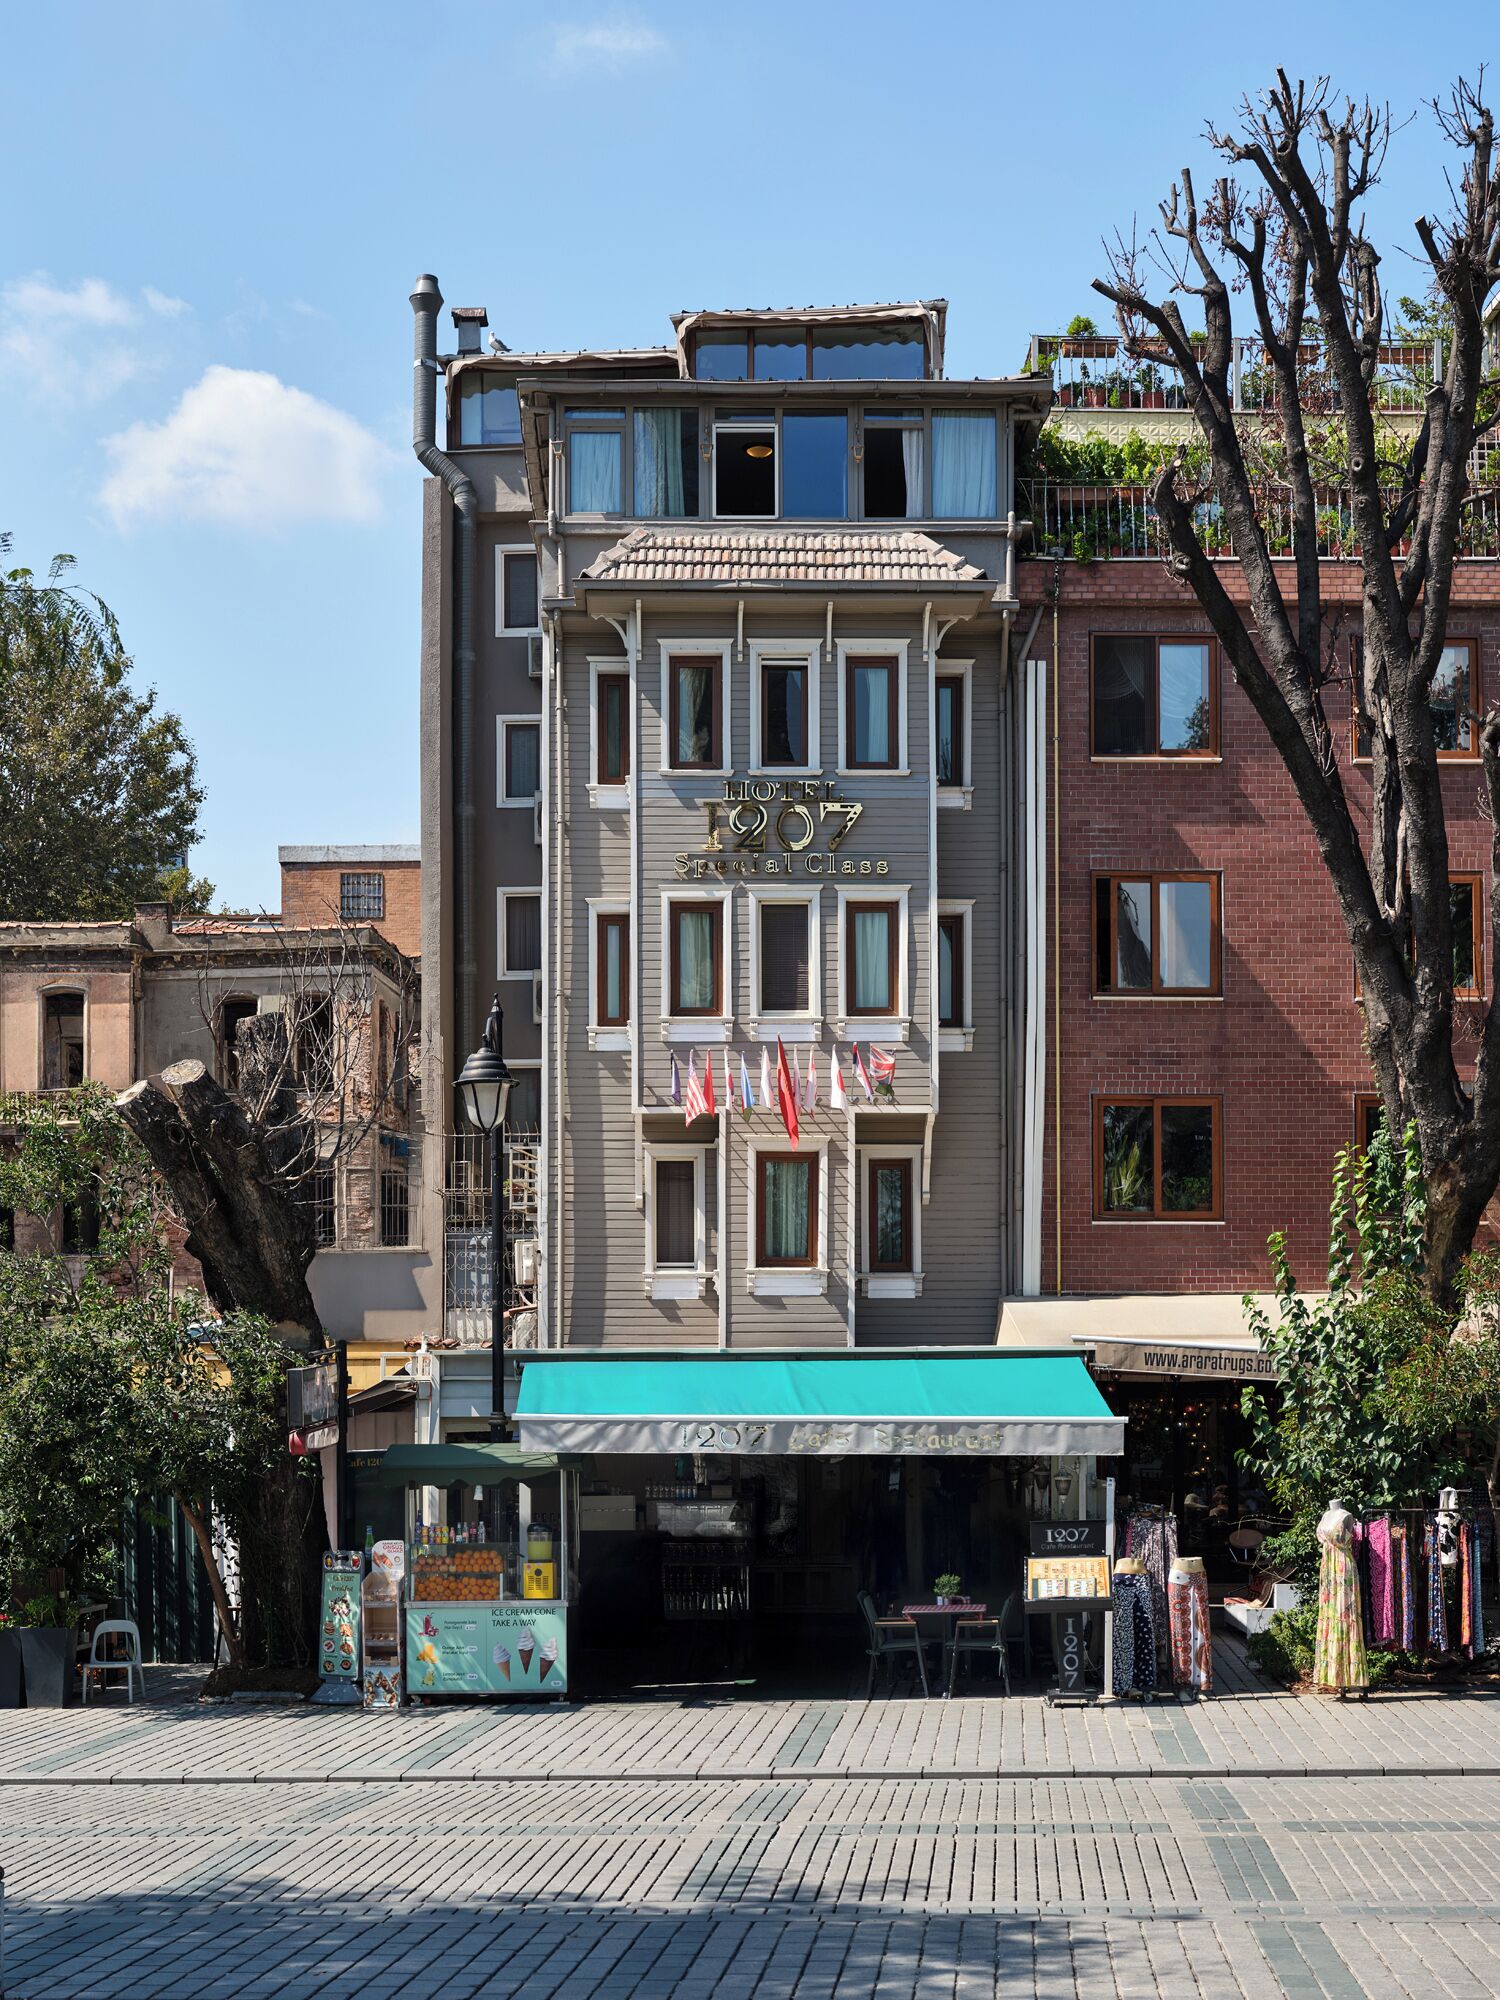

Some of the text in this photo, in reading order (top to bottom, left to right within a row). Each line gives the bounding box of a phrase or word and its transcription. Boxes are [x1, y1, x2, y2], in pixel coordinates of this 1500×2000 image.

[723, 780, 844, 801] HOTEL
[703, 801, 863, 852] 1207
[673, 853, 889, 878] Special Class
[681, 1424, 768, 1448] 1207
[874, 1428, 1004, 1449] Restaurant
[1045, 1528, 1089, 1543] 1207
[491, 1607, 557, 1616] ICE CREAM CONE
[491, 1619, 511, 1627] TAKE
